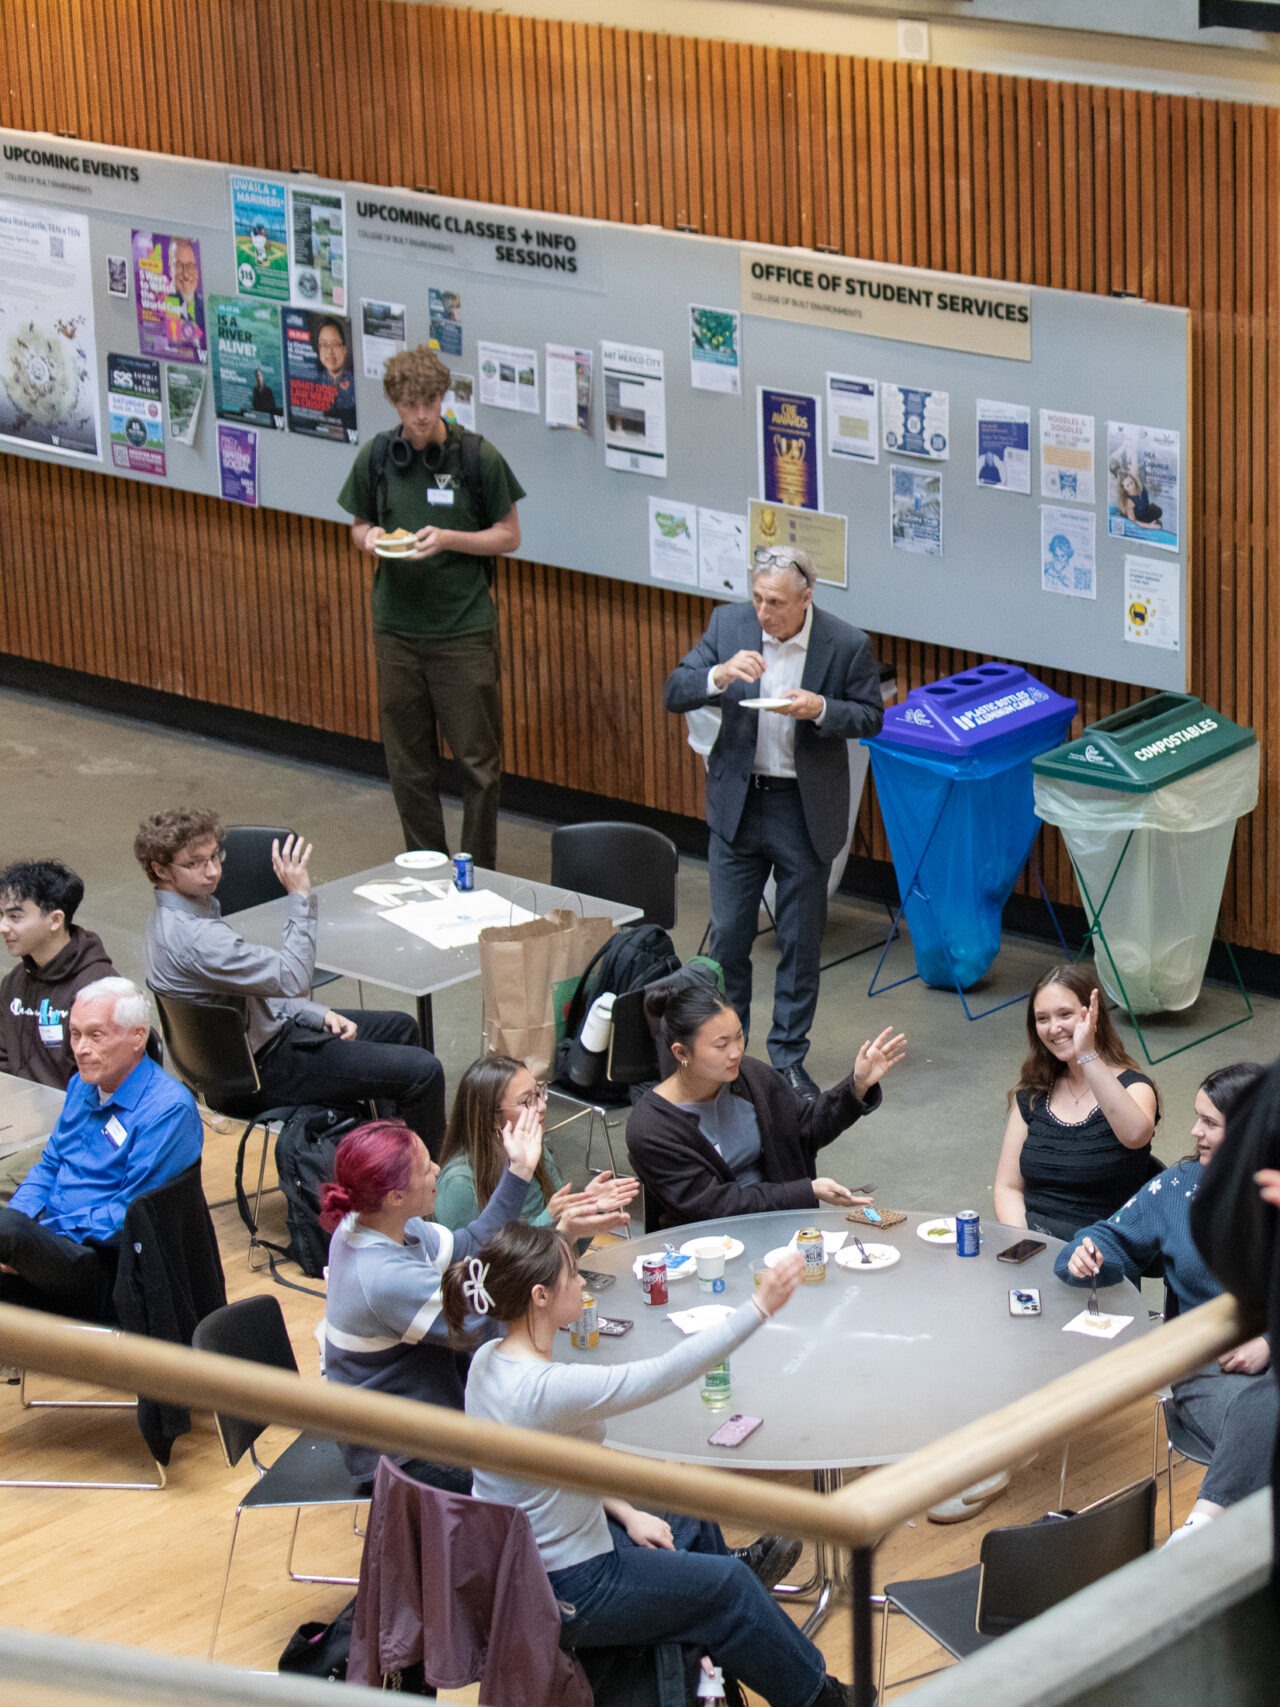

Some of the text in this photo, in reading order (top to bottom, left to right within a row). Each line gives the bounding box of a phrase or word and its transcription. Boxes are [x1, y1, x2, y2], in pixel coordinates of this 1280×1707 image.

[3, 145, 139, 183] UPCOMING EVENTS
[356, 201, 441, 231] UPCOMING
[444, 216, 517, 243] CLASSES
[536, 231, 577, 252] INFO
[495, 246, 578, 273] SESSIONS
[751, 262, 1029, 324] OFFICE OF STUDENT SERVICES
[751, 291, 780, 305] COLLEGE
[217, 314, 238, 327] IS A
[218, 326, 253, 344] RIVER
[218, 338, 257, 357] ALIVE?
[771, 412, 808, 430] AWARDS
[963, 690, 1030, 719] PLASTIC BOTTLES
[974, 698, 1036, 726] ALUMINUM CANS
[1133, 718, 1219, 763] COMPOSTABLES
